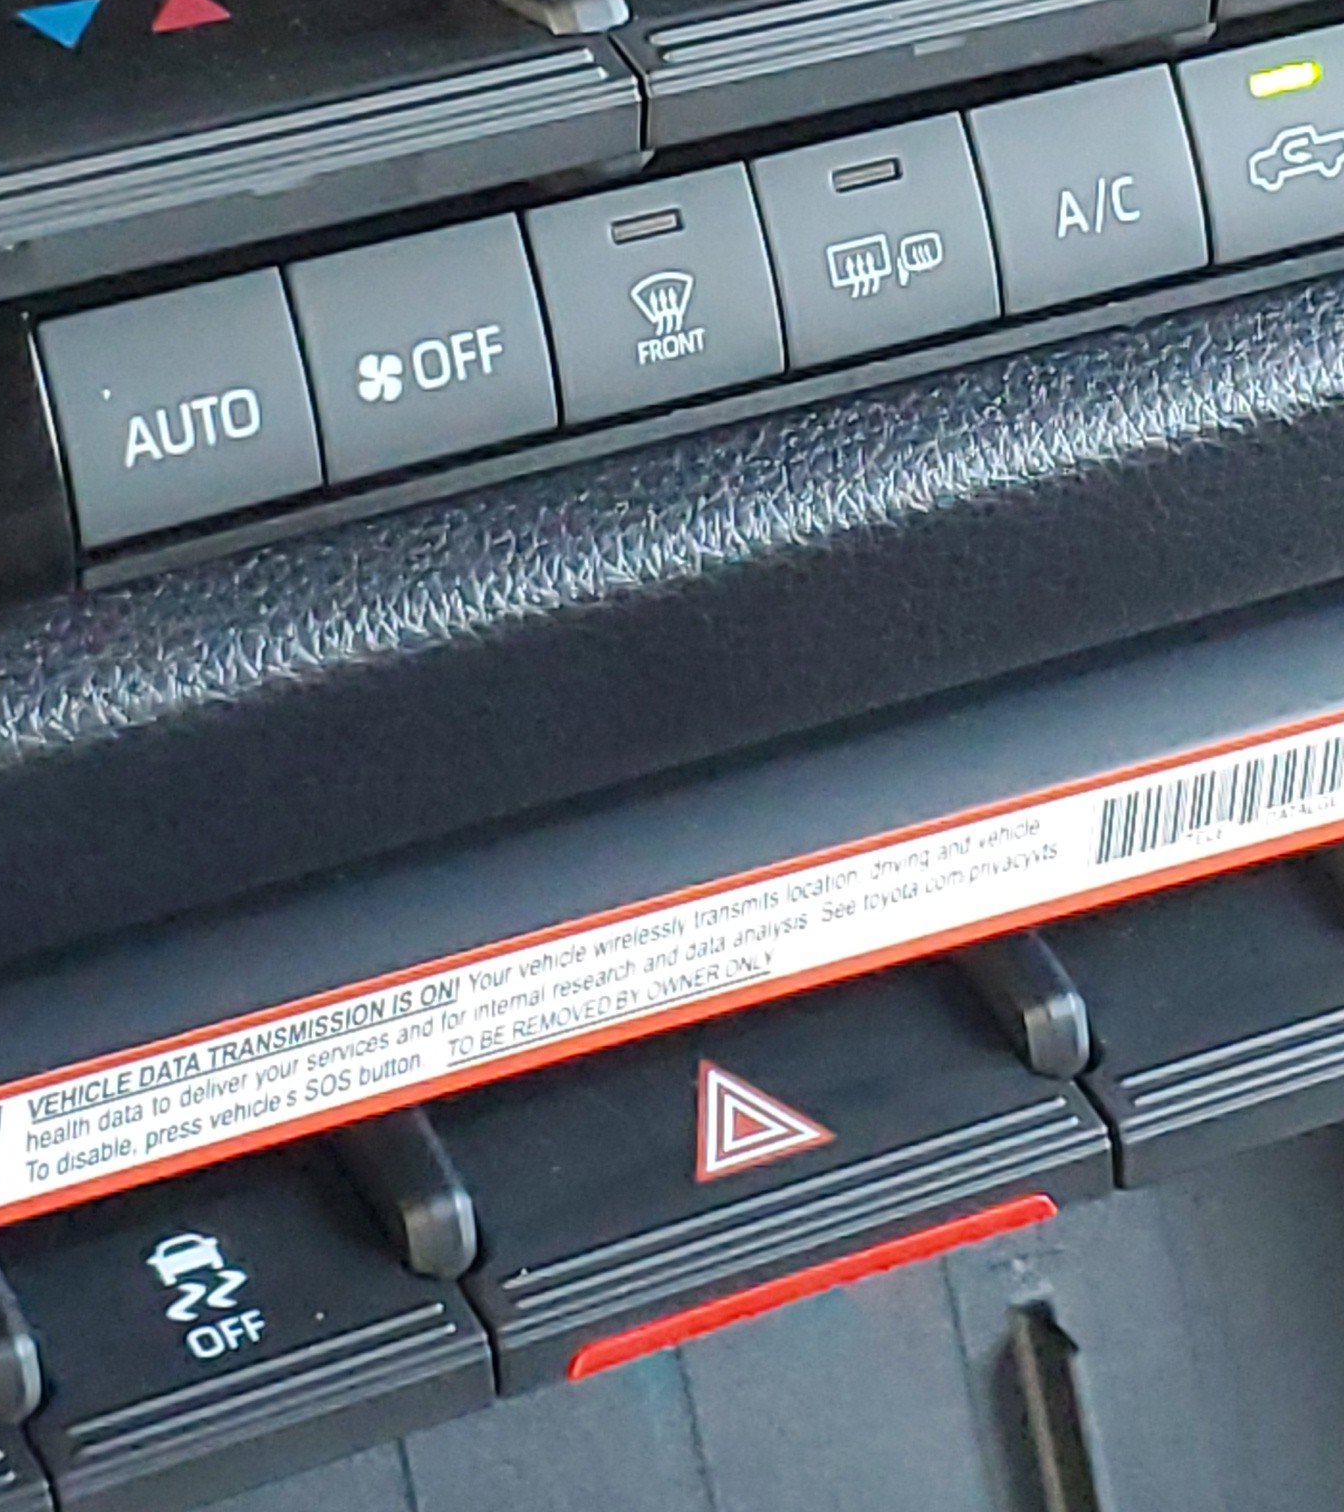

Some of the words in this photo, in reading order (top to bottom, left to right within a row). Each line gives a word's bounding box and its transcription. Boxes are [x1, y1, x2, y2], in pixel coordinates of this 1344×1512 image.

[1057, 175, 1141, 239] A/C
[411, 324, 504, 390] OFF
[636, 326, 707, 366] FRONT
[124, 388, 260, 468] AUTO
[25, 1069, 133, 1120] VEHICLE
[137, 1050, 201, 1089] DATA
[205, 996, 388, 1070] TRANSMISSION
[390, 988, 413, 1017] IS
[419, 974, 461, 1008] ON!
[467, 965, 513, 993] Your
[517, 942, 587, 979] vehicle
[592, 914, 685, 958] wirelessly
[693, 890, 779, 930] transmits
[785, 869, 858, 903] location
[936, 834, 971, 861] and
[978, 818, 1040, 849] vehicle
[24, 1115, 91, 1154] health
[96, 1102, 144, 1133] data
[150, 1094, 172, 1118] to
[178, 1071, 249, 1109] deliver
[254, 1057, 299, 1092] your
[305, 1030, 390, 1072] services
[394, 1014, 434, 1046] and
[440, 1008, 467, 1033] for
[473, 984, 545, 1022] internal
[551, 958, 636, 999] research
[642, 944, 679, 974] and
[684, 934, 726, 962] data
[732, 911, 808, 949] analysis
[820, 898, 856, 923] See
[24, 1157, 50, 1184] To
[55, 1135, 138, 1176] disable,
[143, 1115, 203, 1156] press
[208, 1088, 298, 1130] vehicles
[303, 1067, 352, 1103] SOS
[446, 1033, 474, 1057] TO
[478, 1023, 506, 1051] BE
[511, 994, 612, 1041] REMOVED
[614, 987, 639, 1011] BY
[646, 962, 720, 1001] OWNER
[724, 950, 772, 978] ONLY
[186, 1309, 265, 1359] OFF
